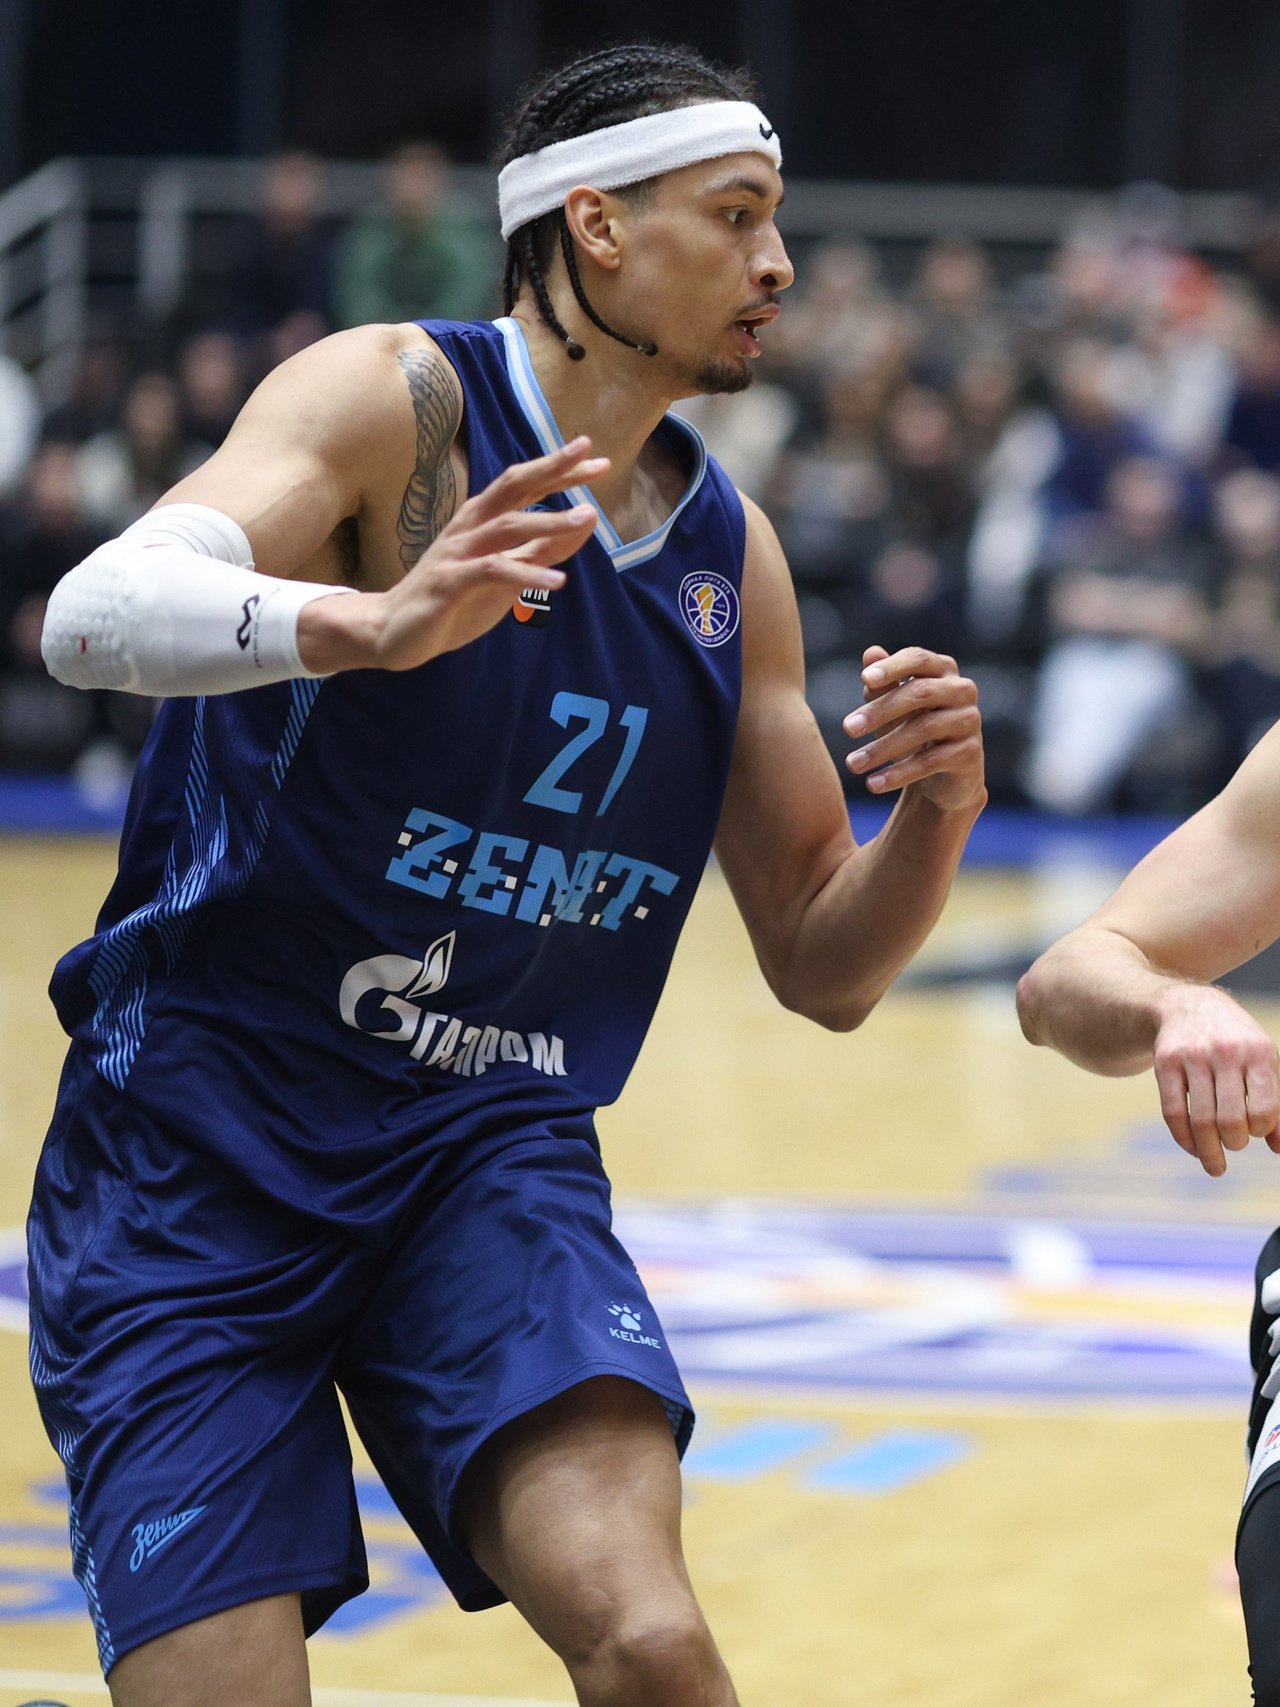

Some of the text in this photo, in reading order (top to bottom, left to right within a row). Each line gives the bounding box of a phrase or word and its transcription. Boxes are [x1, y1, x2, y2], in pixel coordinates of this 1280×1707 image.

[522, 690, 649, 817] 21
[385, 807, 681, 931] ZENIT
[608, 1327, 661, 1349] KELME
[130, 1504, 208, 1573] Зенит
